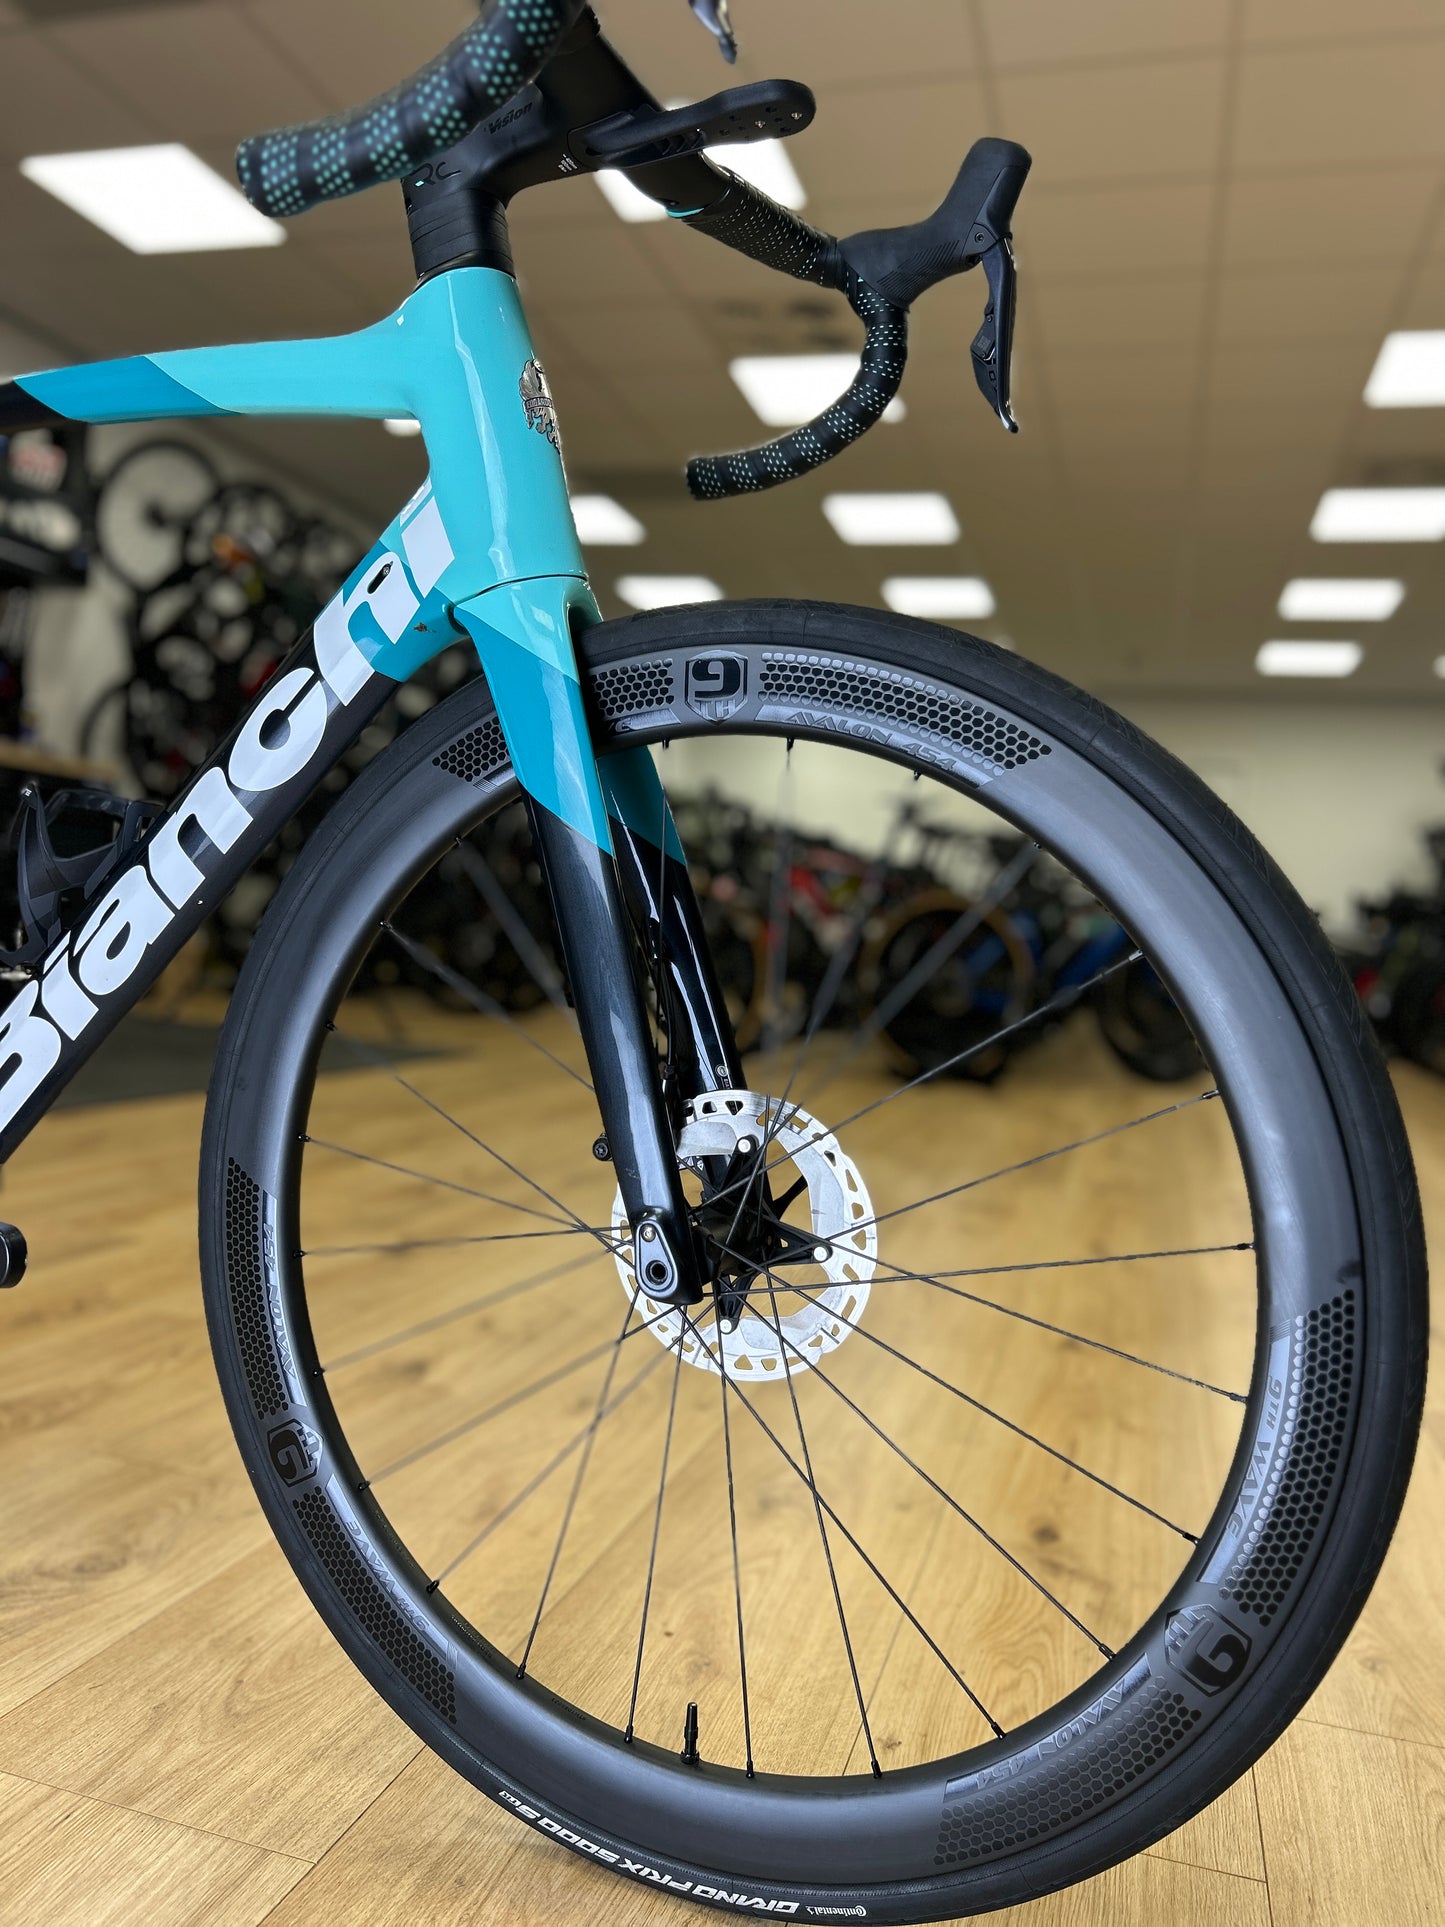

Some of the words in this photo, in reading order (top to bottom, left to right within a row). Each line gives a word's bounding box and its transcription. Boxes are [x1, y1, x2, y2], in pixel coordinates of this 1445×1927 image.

[488, 102, 533, 135] Vision
[784, 711, 894, 745] AVALON
[901, 742, 957, 771] 454
[263, 1222, 276, 1273] 454
[267, 1283, 297, 1380] AVALON
[1265, 1375, 1283, 1430] 9TH
[1038, 1678, 1125, 1760] AVALON
[975, 1756, 1026, 1790] 454
[537, 1817, 620, 1863] 5000
[618, 1857, 694, 1892] PRIX
[691, 1884, 801, 1914] GRAND
[813, 1904, 867, 1918] Continental
